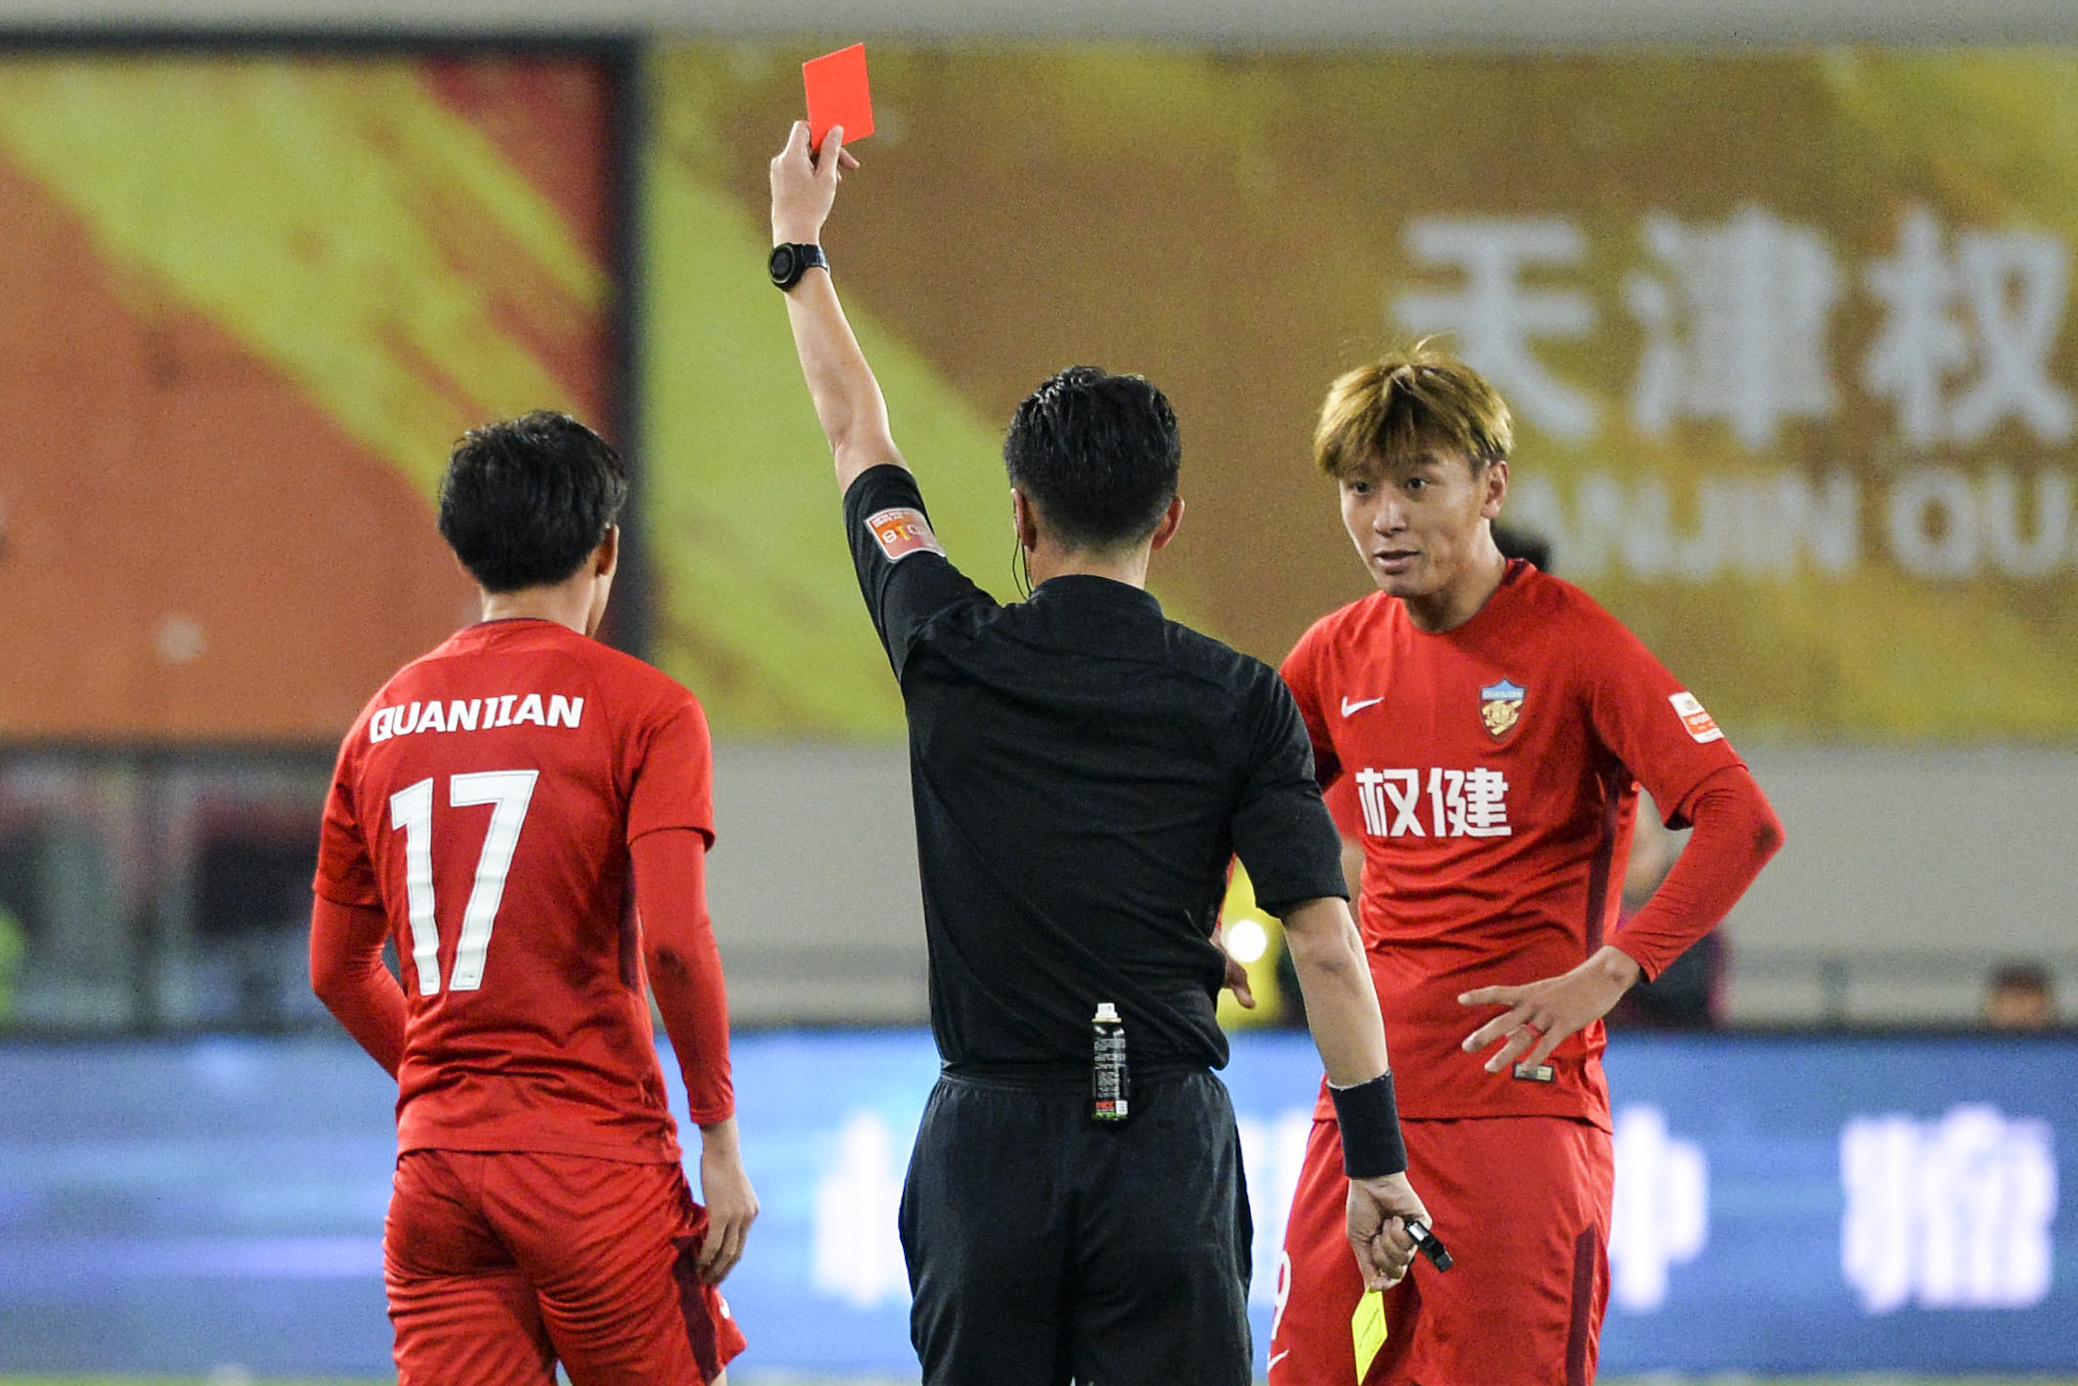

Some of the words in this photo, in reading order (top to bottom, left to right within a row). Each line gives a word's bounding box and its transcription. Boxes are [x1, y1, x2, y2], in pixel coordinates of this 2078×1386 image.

[1505, 470, 1860, 586] ANJIN
[369, 694, 584, 744] QUANJIAN
[1355, 766, 1512, 838] 权健
[389, 769, 540, 996] 17
